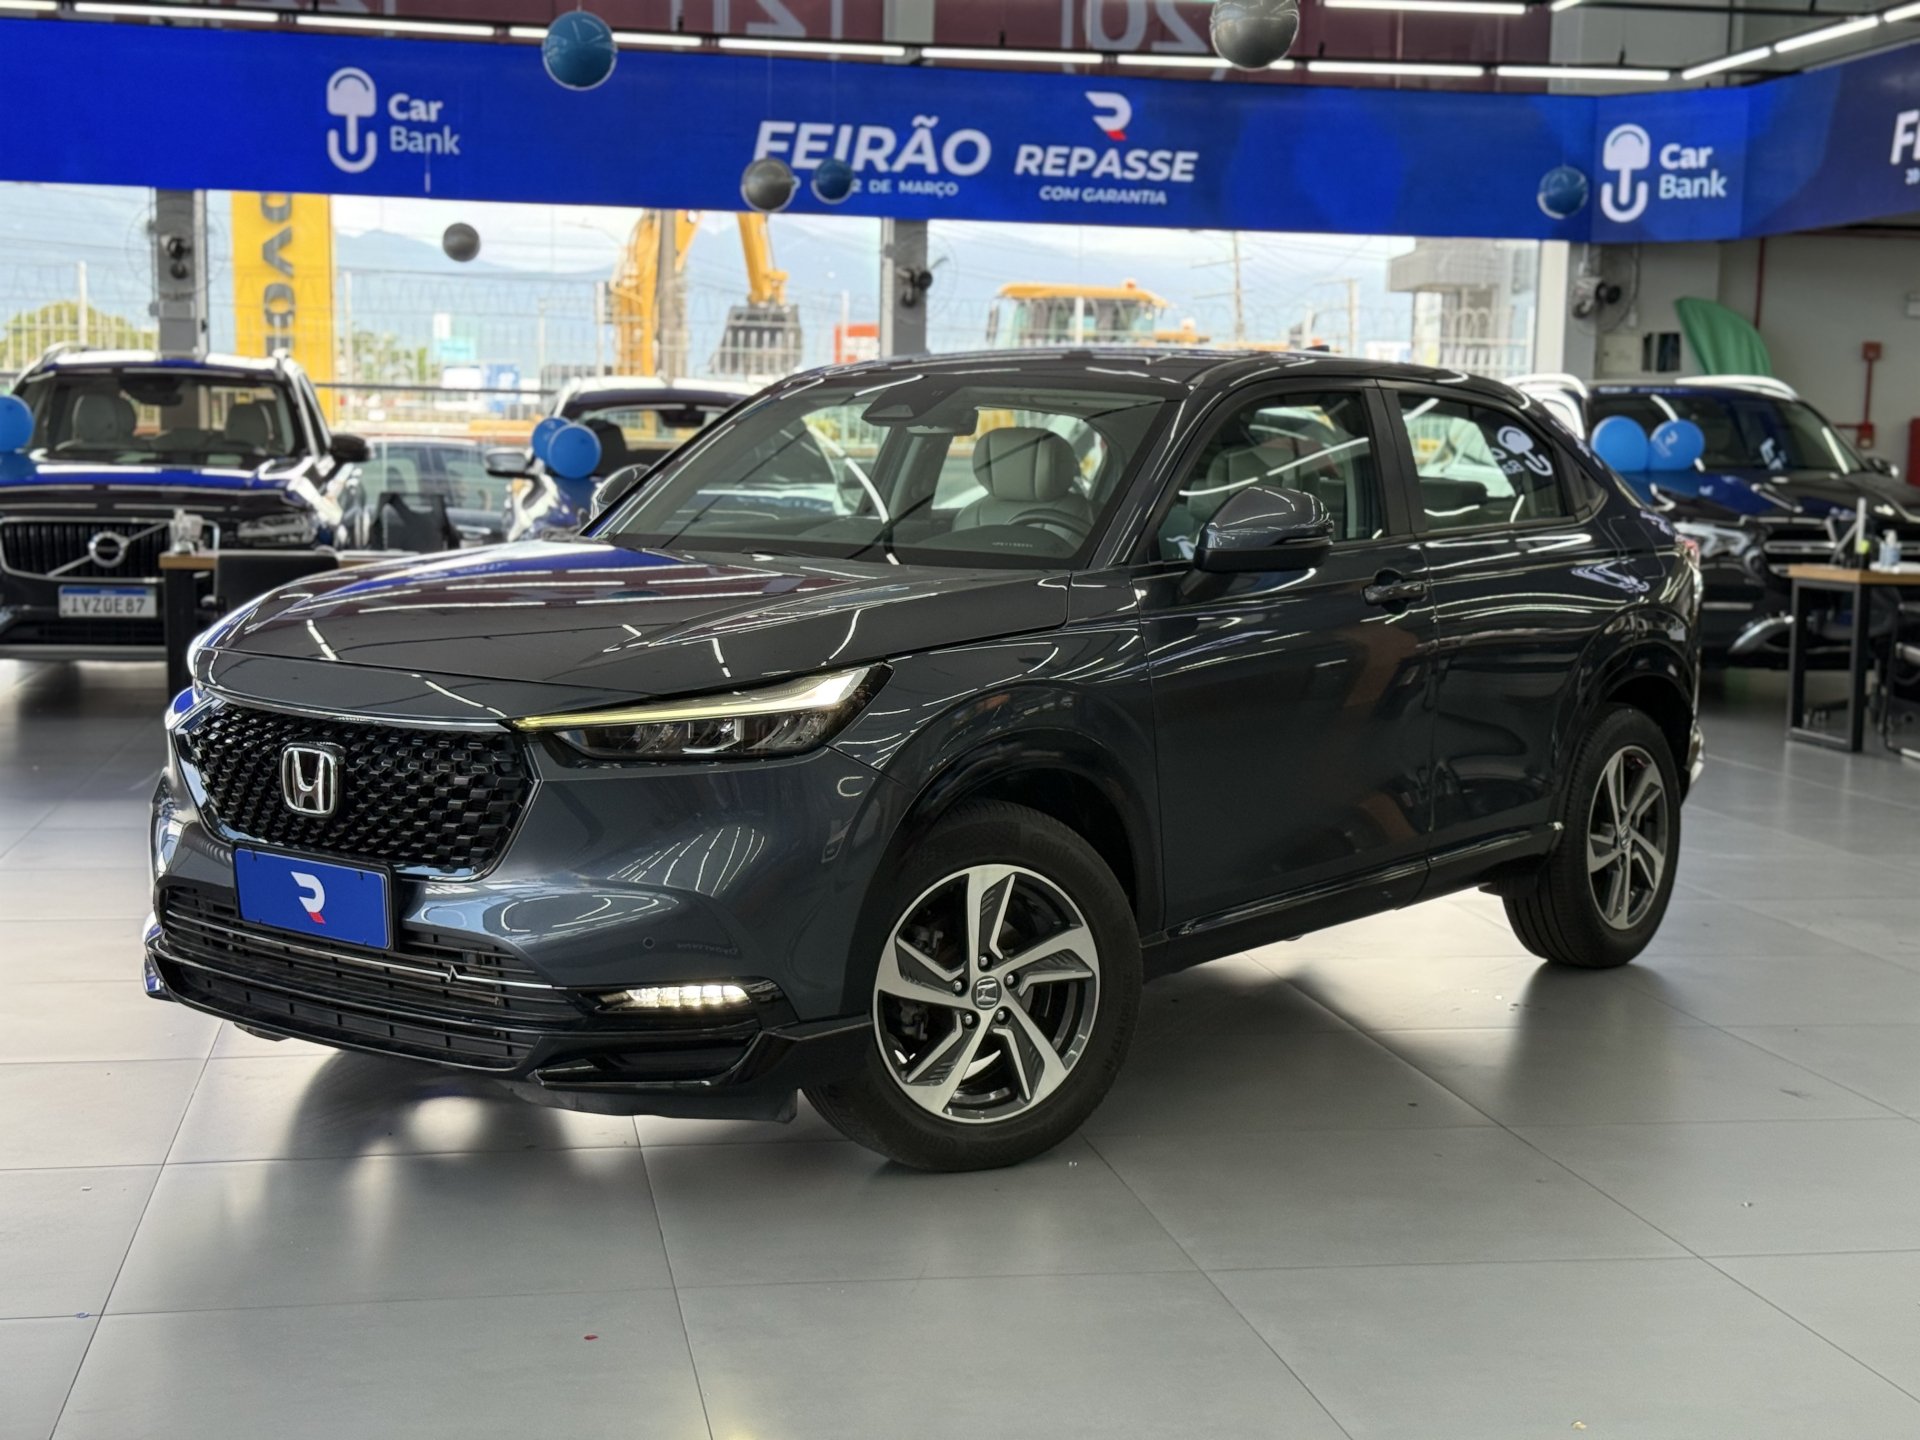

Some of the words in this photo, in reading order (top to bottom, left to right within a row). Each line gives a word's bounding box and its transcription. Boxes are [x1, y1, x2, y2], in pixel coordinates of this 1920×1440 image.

[388, 93, 443, 121] Car
[390, 126, 460, 154] Bank
[753, 115, 992, 177] FEIRÃO
[1014, 144, 1199, 183] REPASSE
[1660, 143, 1713, 170] Car
[868, 179, 892, 194] DE
[898, 179, 959, 197] MARÇO
[1039, 185, 1079, 202] COM
[1081, 187, 1168, 205] GARANTIA
[1658, 169, 1728, 199] Bank
